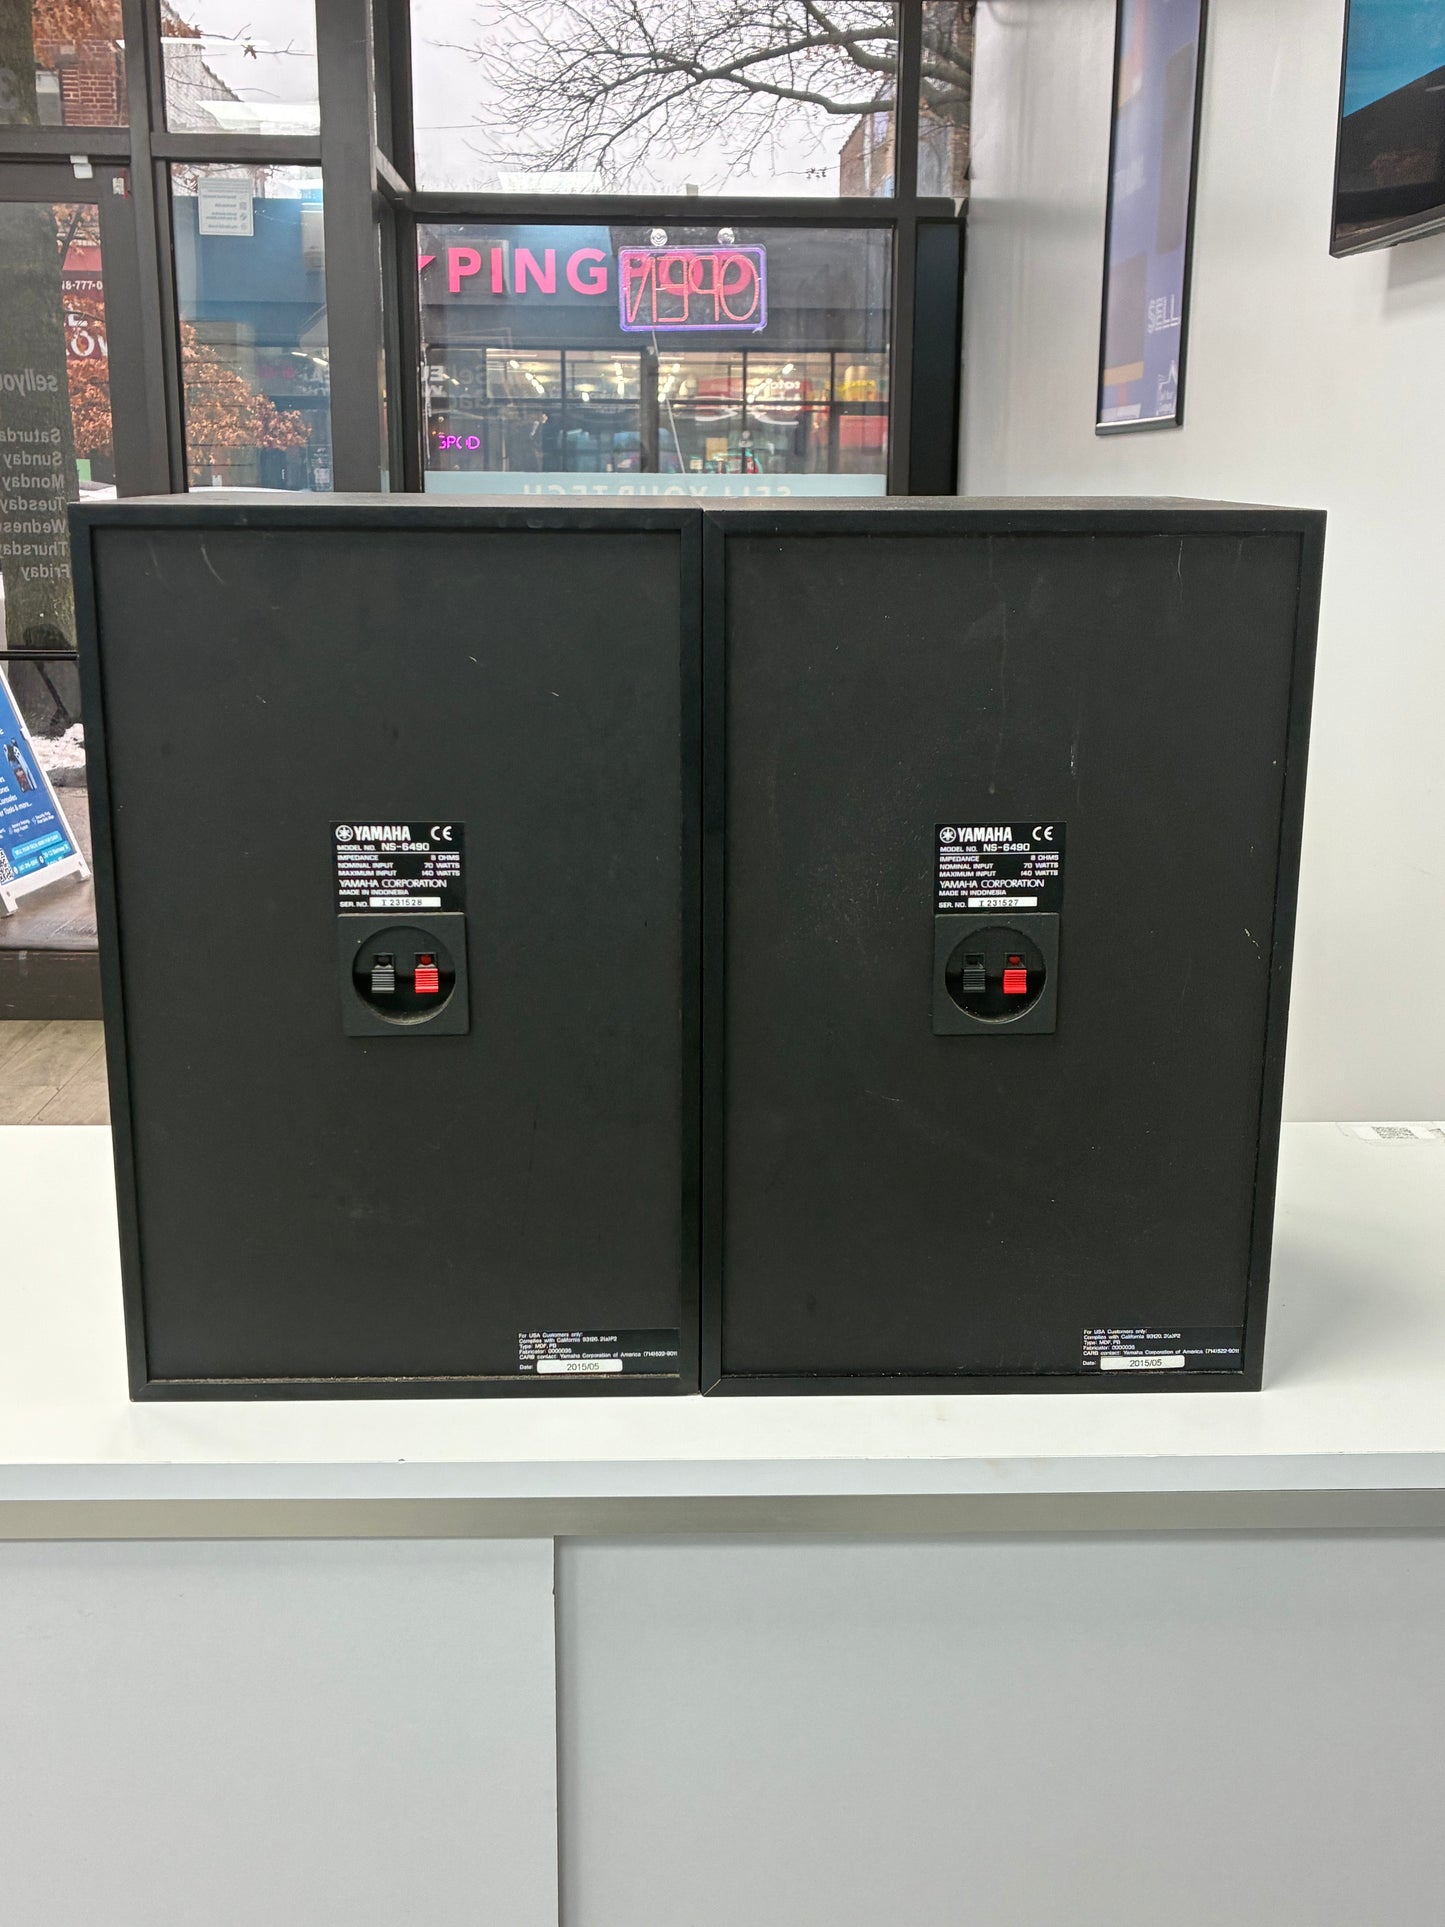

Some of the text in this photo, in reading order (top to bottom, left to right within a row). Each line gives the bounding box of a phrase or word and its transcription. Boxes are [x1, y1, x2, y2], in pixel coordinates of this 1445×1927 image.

[353, 825, 453, 841] YAMAHA CE
[957, 826, 1054, 842] YAMAHA CE
[381, 842, 430, 851] NS-6490
[983, 843, 1030, 852] NS-6490
[339, 879, 447, 888] YAMAHA CORPORATION
[940, 879, 1045, 889] YAMAHA CORPORATION
[939, 889, 959, 897] MADE
[938, 901, 954, 909] SER.
[987, 899, 1020, 907] 231527
[566, 1363, 600, 1371] 2015/05
[1129, 1359, 1162, 1367] 2015/05
